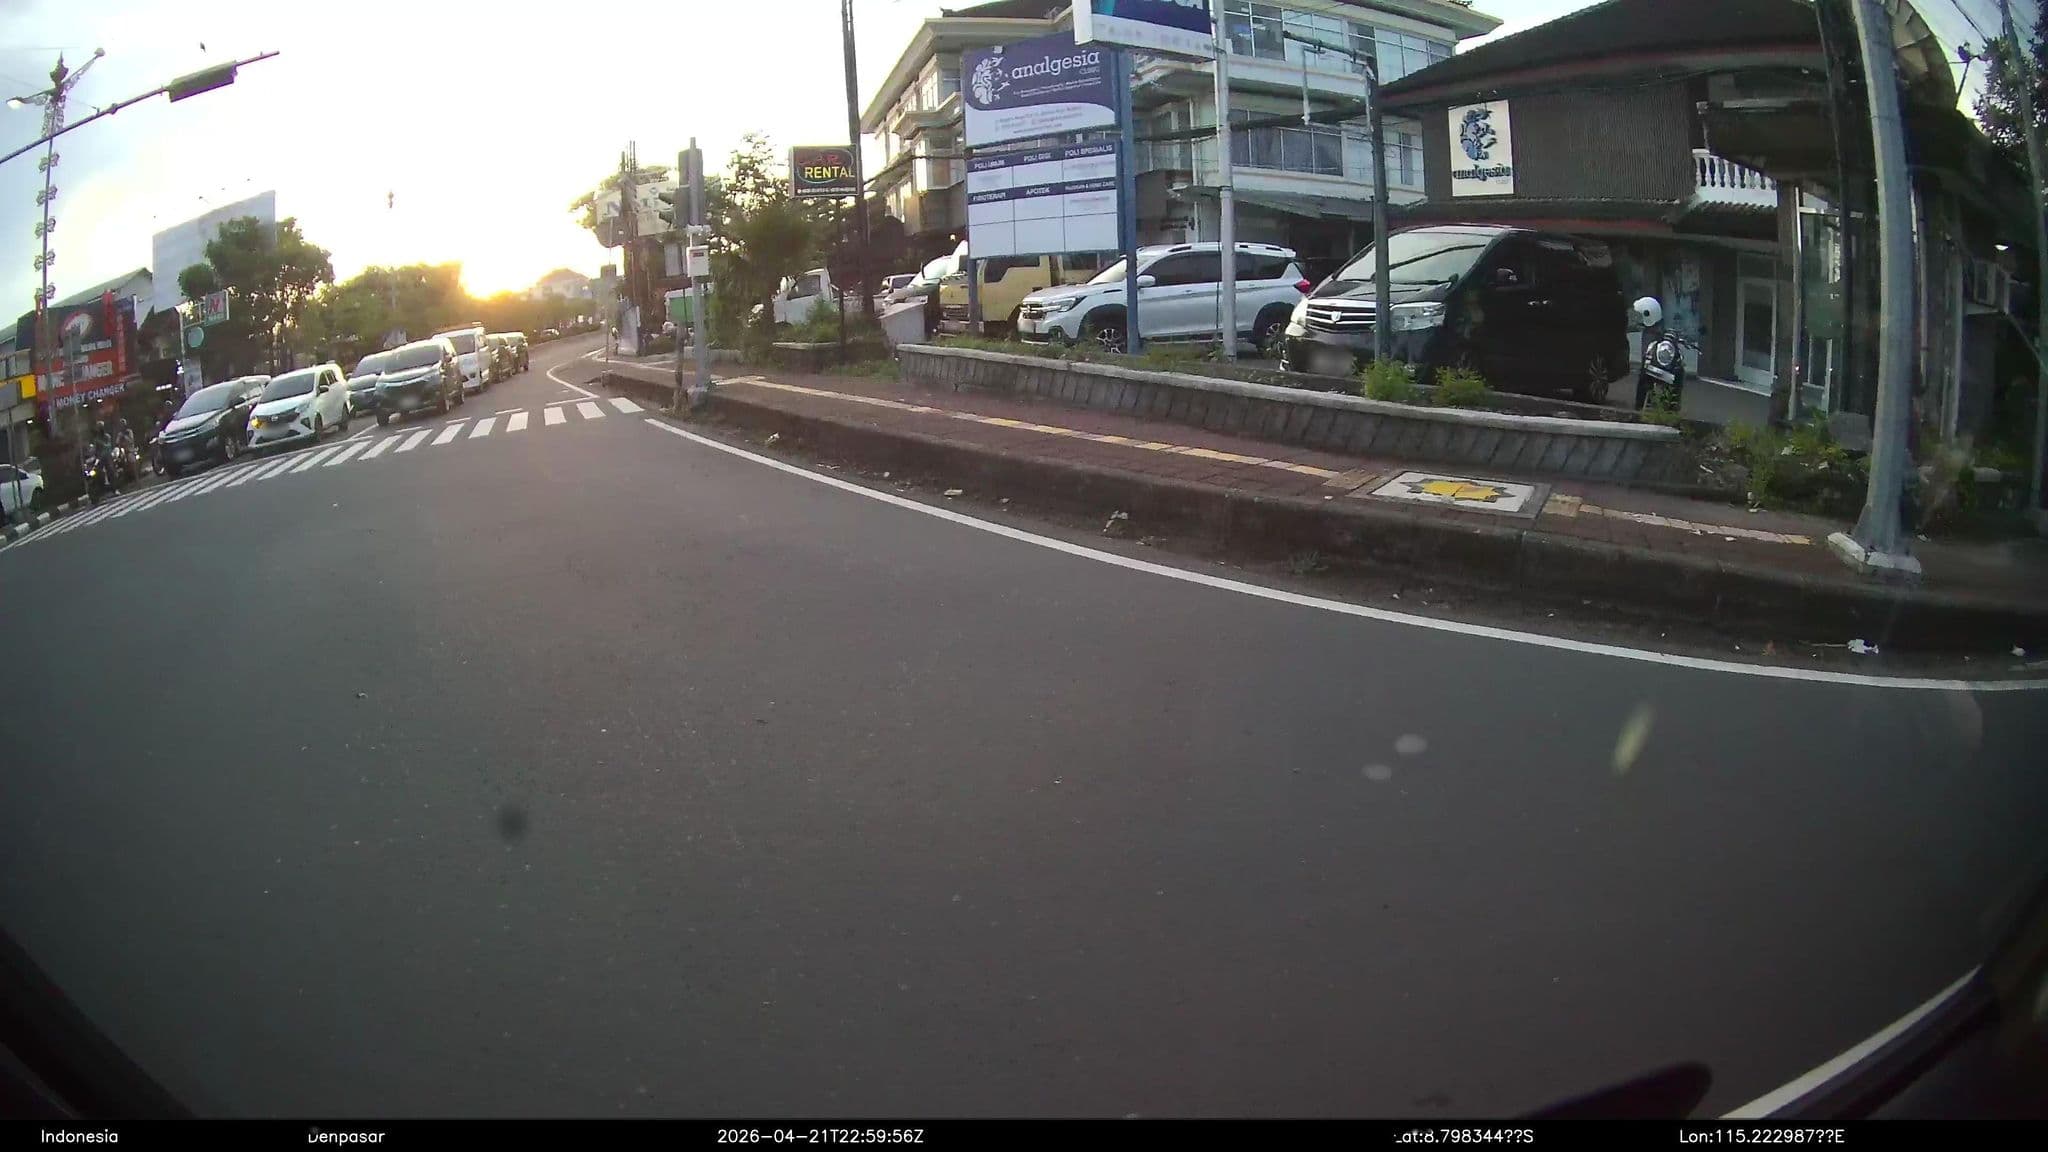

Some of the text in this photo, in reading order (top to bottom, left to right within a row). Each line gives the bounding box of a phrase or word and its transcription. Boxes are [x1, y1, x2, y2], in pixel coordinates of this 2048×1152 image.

[1012, 50, 1100, 79] analgesia
[804, 166, 855, 179] RENTAL
[55, 383, 125, 408] MONEY CHANGER
